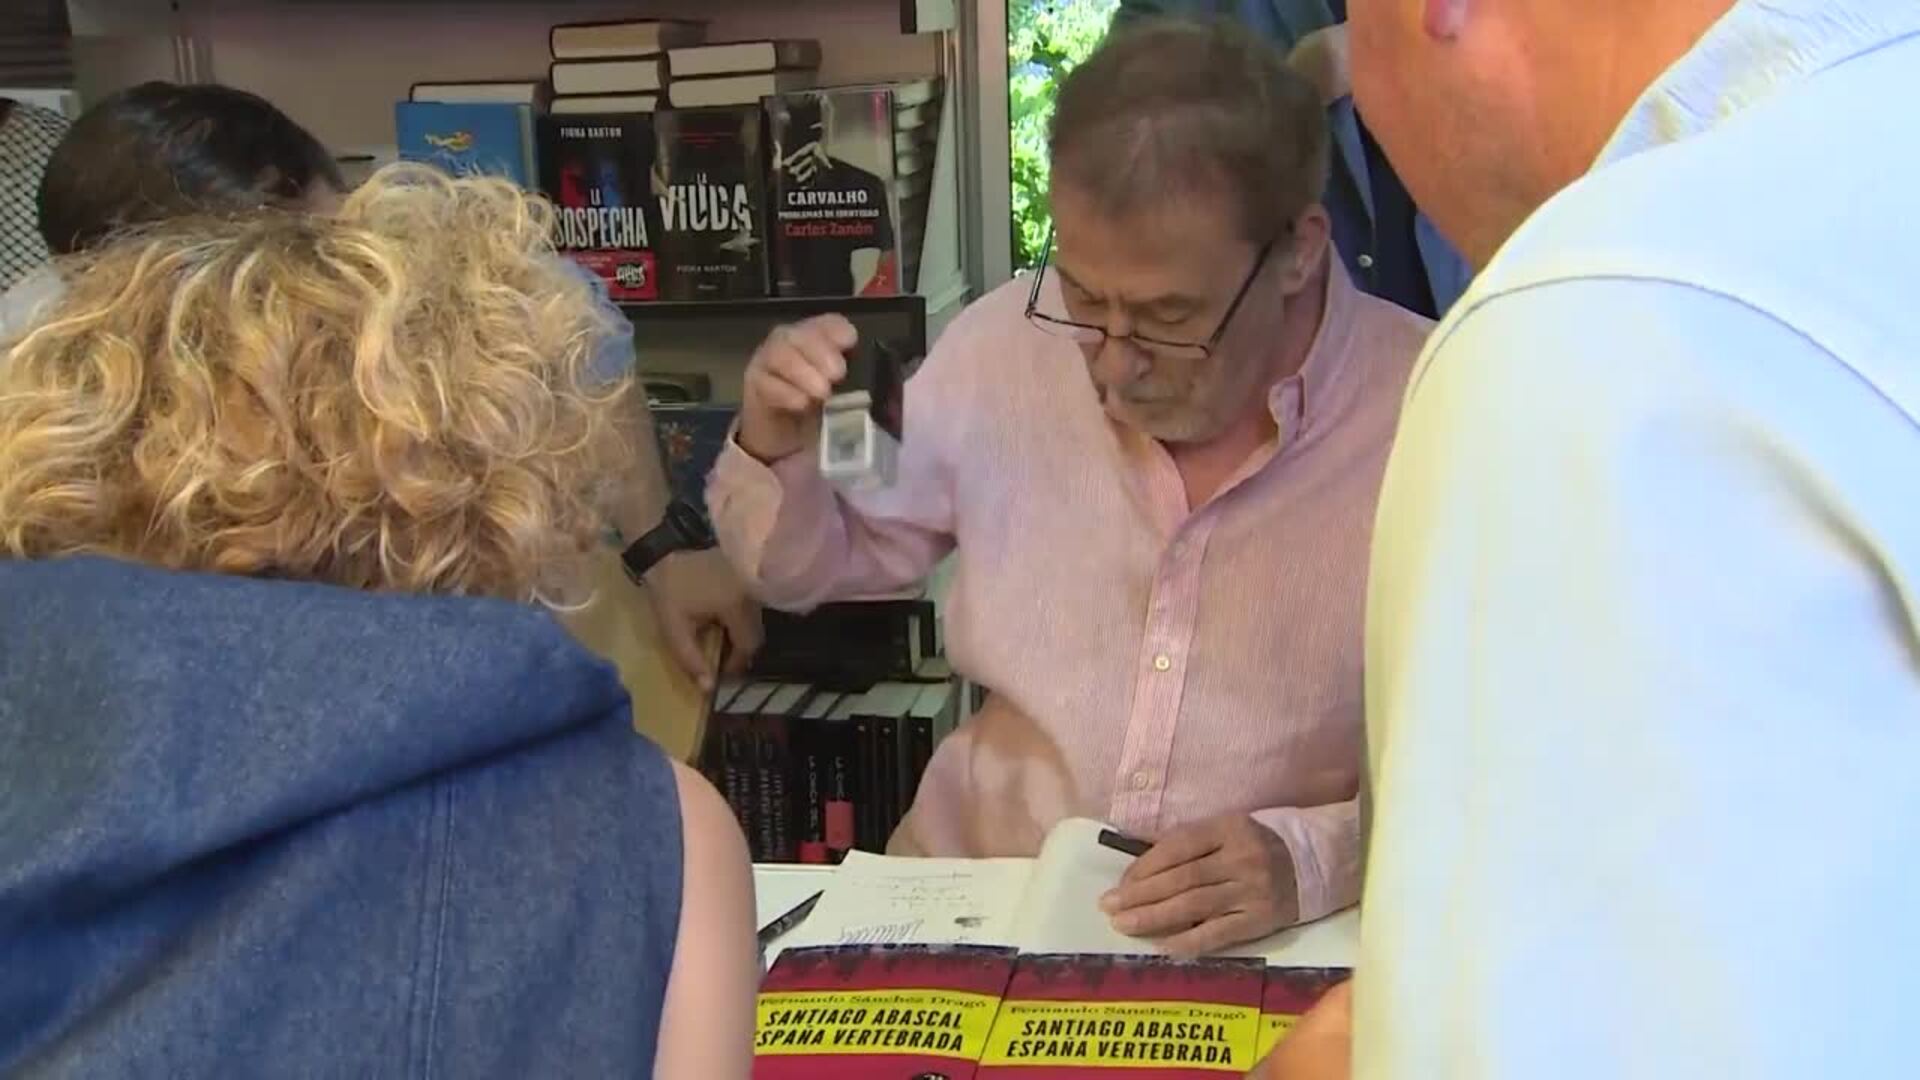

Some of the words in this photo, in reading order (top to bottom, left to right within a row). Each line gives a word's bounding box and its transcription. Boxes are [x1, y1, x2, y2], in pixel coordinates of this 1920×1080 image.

[590, 189, 600, 205] LA
[659, 184, 752, 231] VIUDA
[787, 190, 868, 205] CARVALHO
[556, 207, 649, 248] SOSPECHA
[785, 222, 827, 237] Carlos
[829, 220, 874, 235] Zanón
[765, 1008, 868, 1028] SANTIAGO
[872, 1008, 963, 1029] ABASCAL
[833, 1029, 964, 1052] VERTEBRADA
[1021, 1019, 1127, 1038] SANTIAGO
[1132, 1021, 1229, 1042] ABASCAL
[1006, 1037, 1088, 1058] ESPAÑA
[1097, 1041, 1233, 1065] VERTEBRADA
